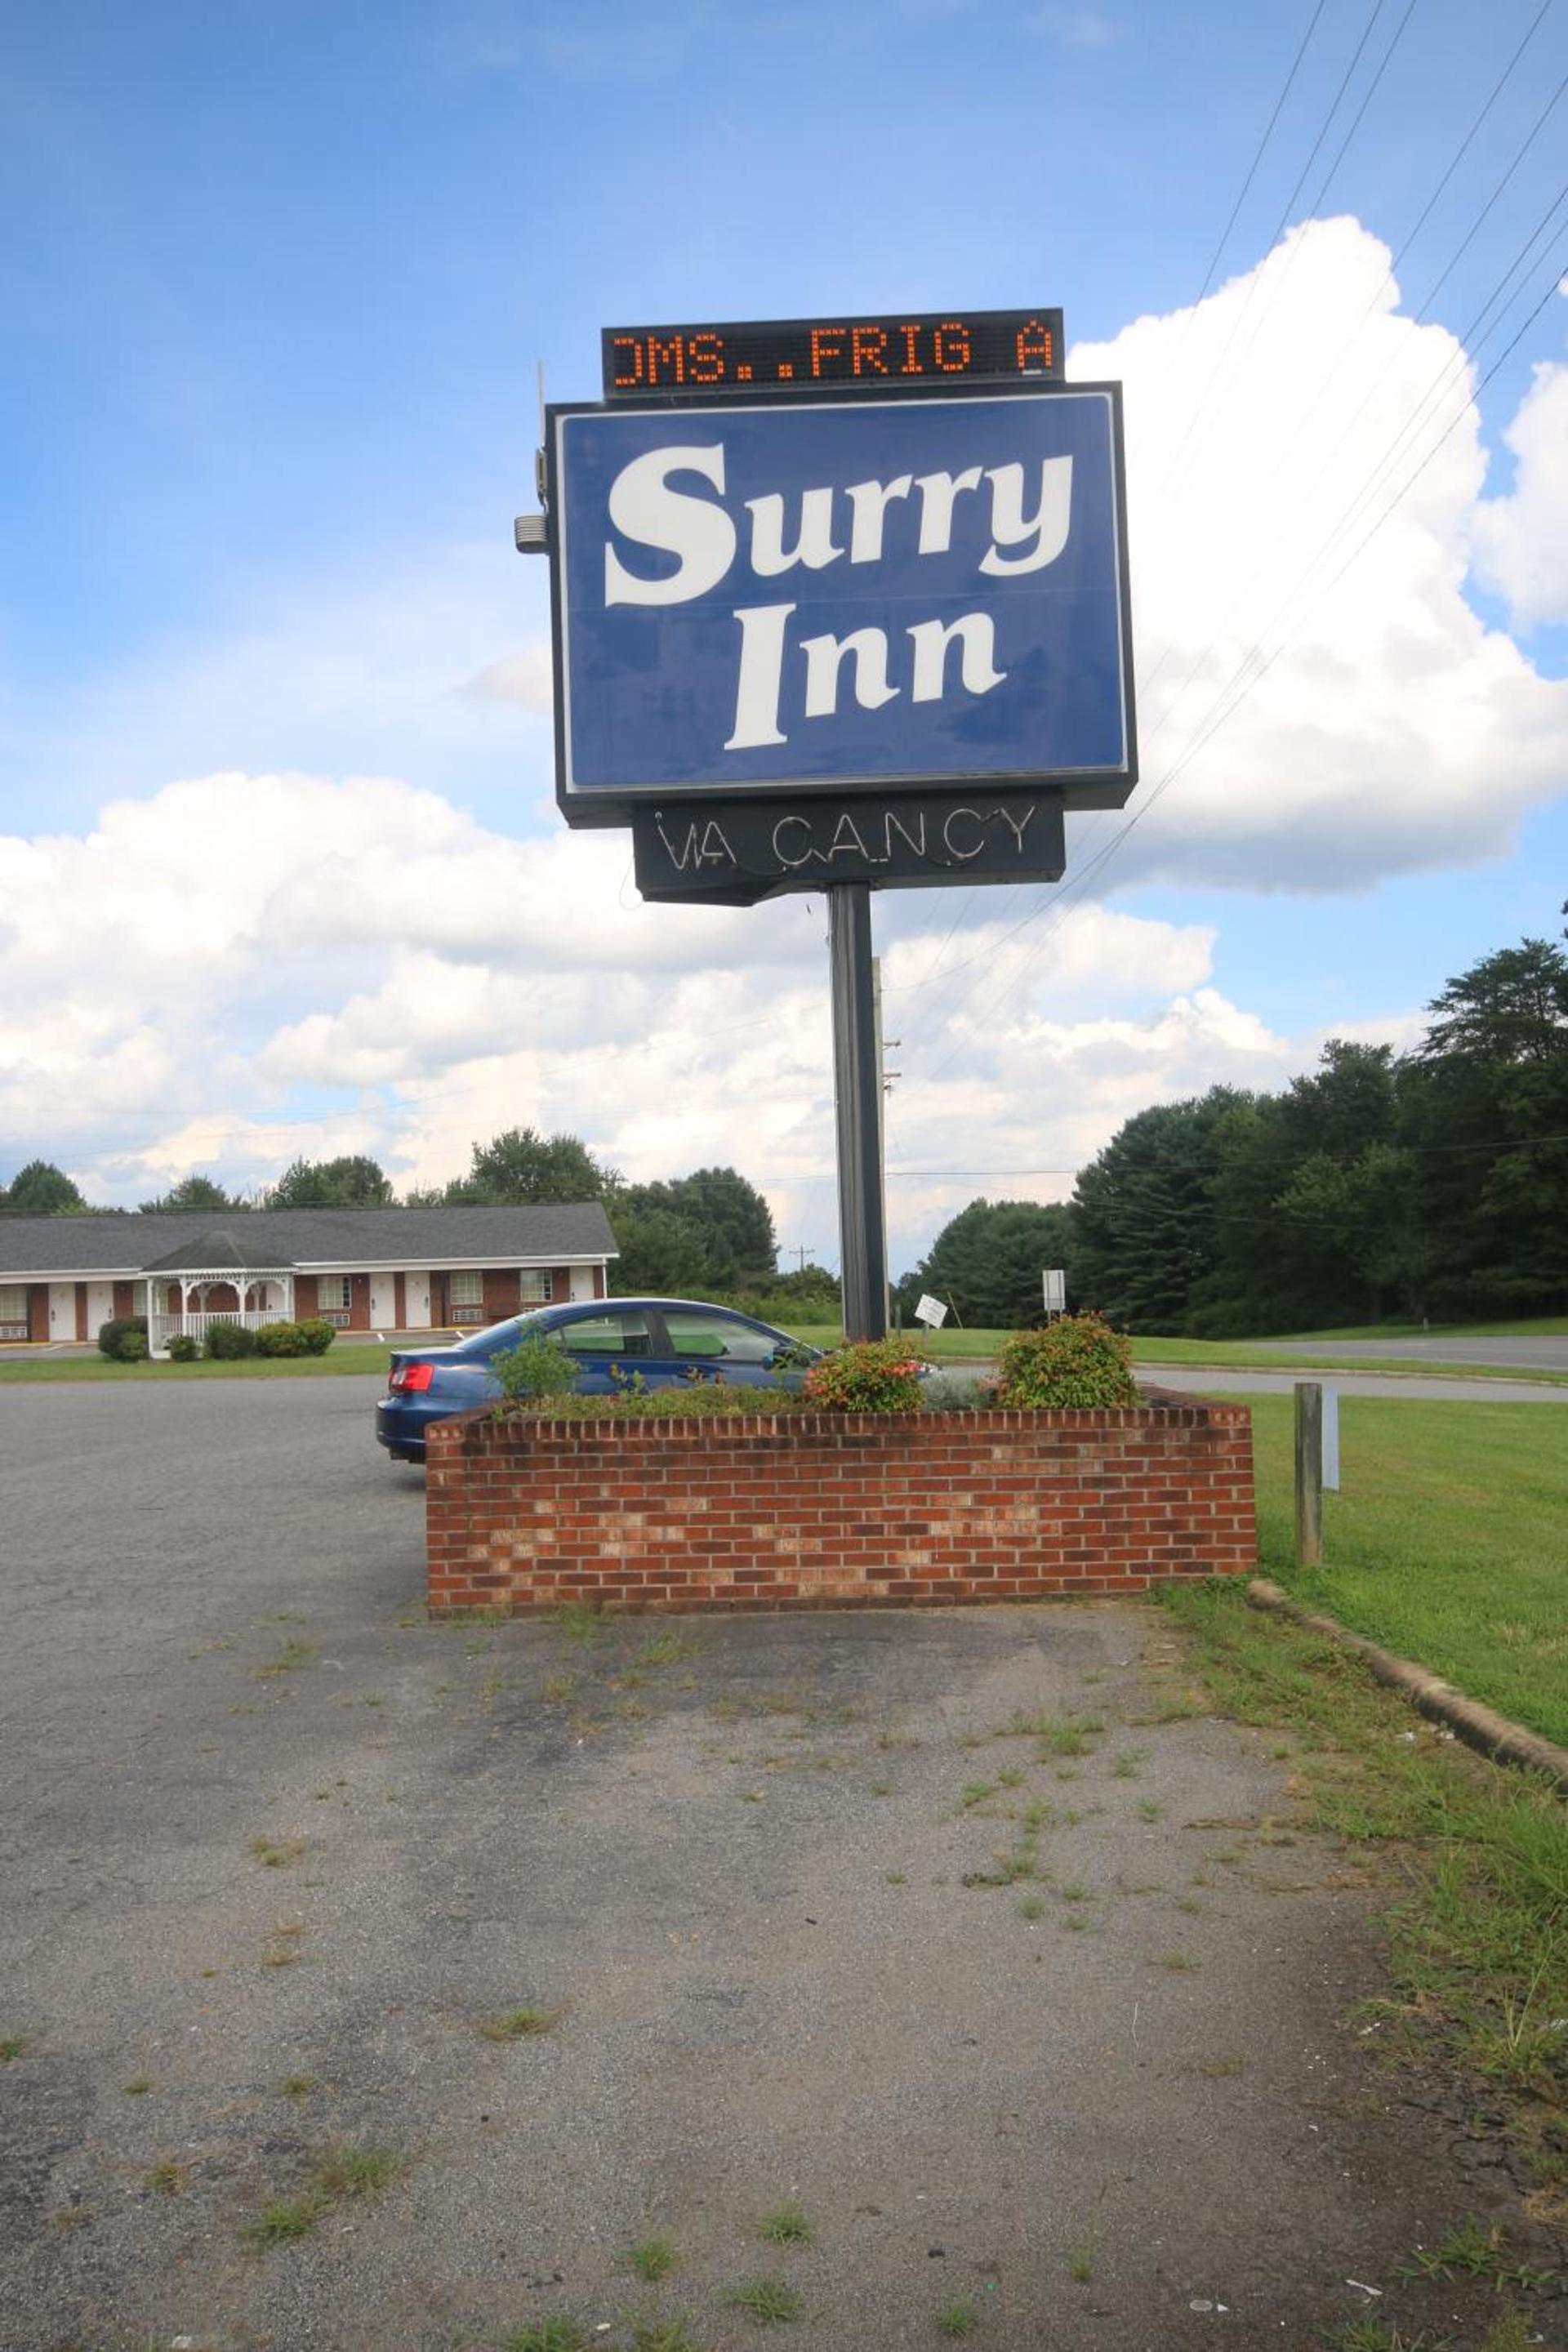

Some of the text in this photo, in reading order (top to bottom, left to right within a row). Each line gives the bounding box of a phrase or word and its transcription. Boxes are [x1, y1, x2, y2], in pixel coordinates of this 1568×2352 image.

[1015, 319, 1052, 369] A
[604, 442, 1074, 608] Surry
[724, 602, 1007, 751] Inn
